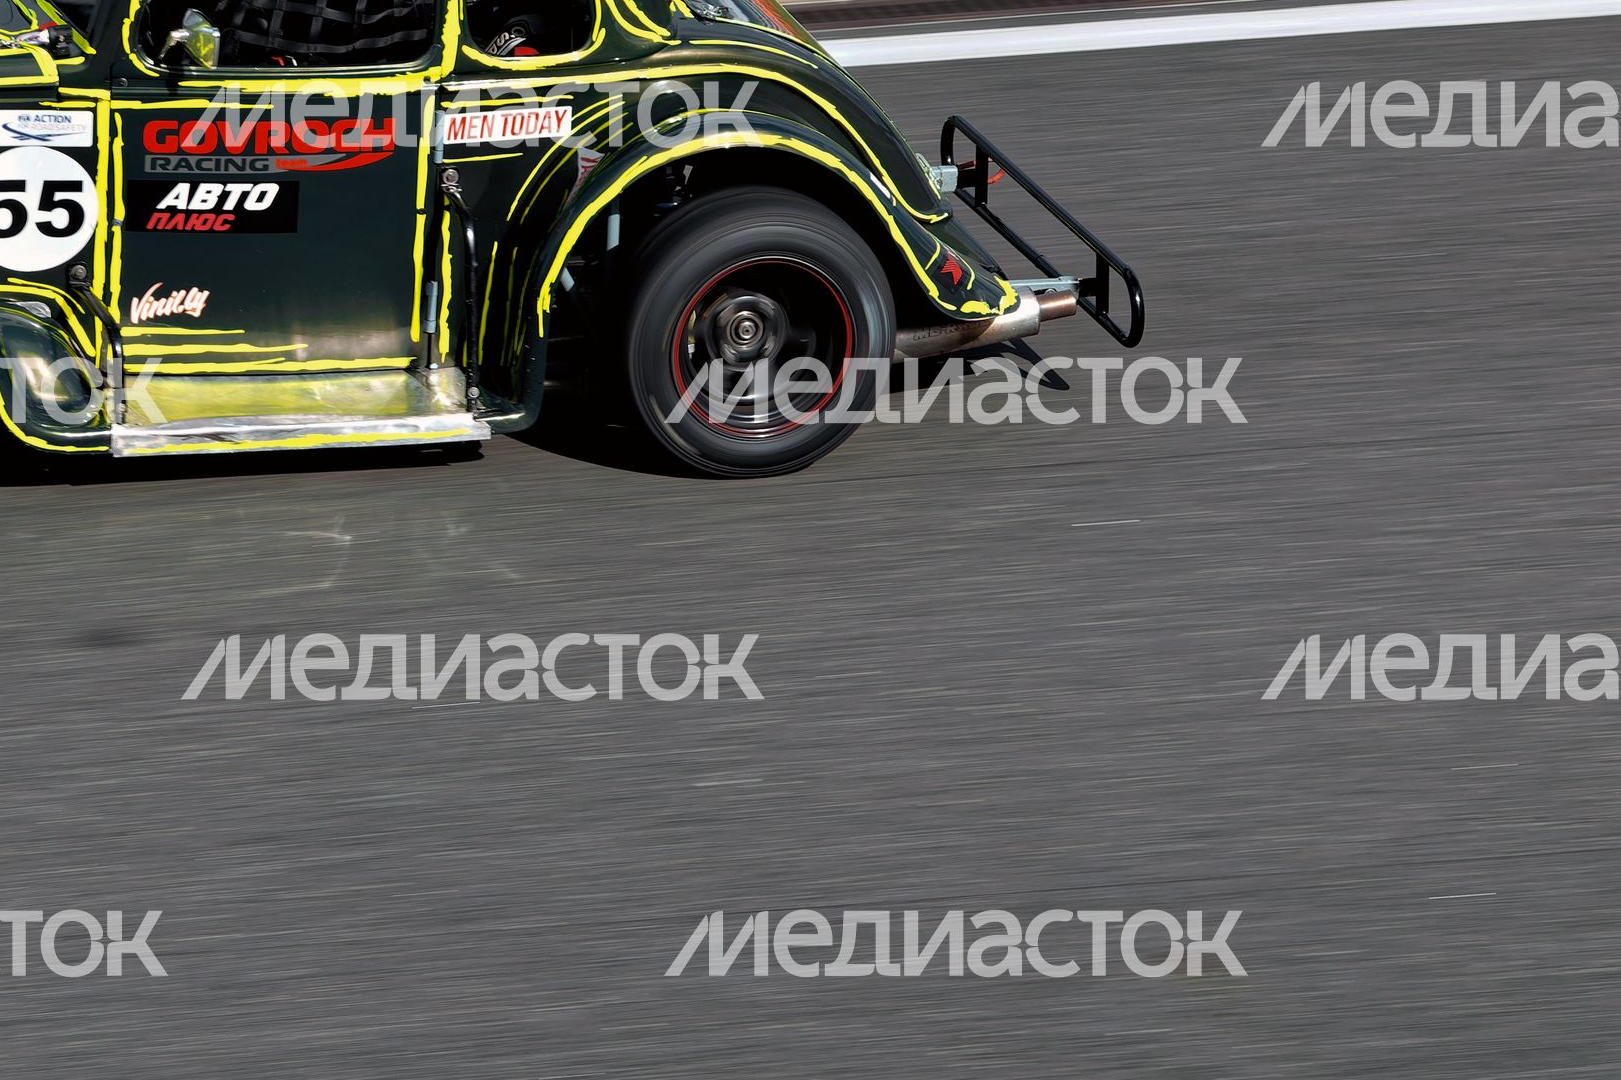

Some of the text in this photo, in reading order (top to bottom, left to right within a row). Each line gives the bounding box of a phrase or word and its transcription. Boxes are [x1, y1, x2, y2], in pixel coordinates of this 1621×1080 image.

[447, 109, 568, 141] MEN TODAY
[150, 157, 269, 172] RACING
[156, 183, 281, 211] АВТО
